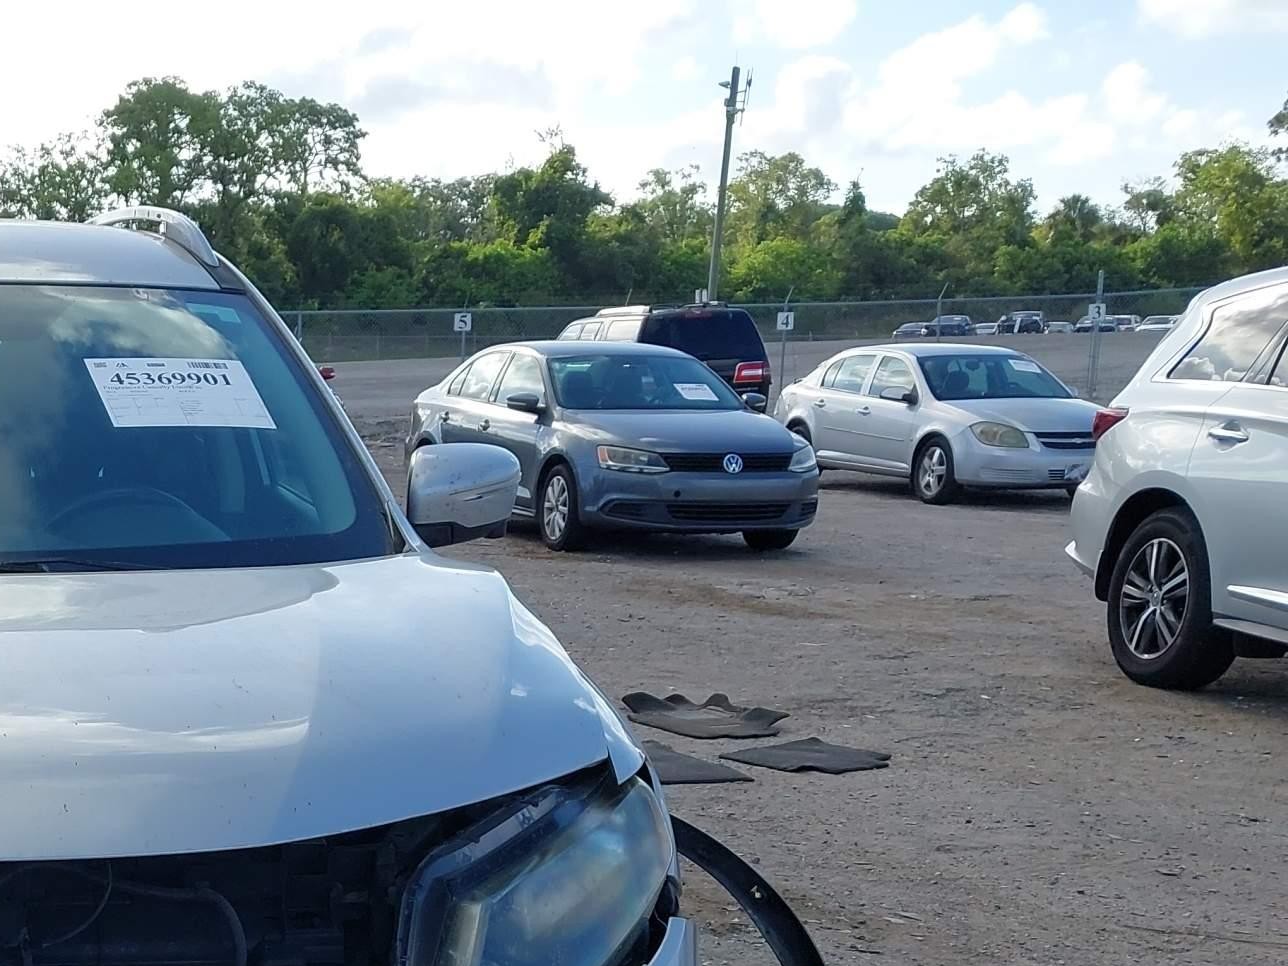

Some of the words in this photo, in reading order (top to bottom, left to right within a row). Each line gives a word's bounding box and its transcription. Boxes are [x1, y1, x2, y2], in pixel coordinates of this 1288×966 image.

[1091, 305, 1101, 319] 3
[458, 314, 468, 329] 5
[780, 315, 789, 327] 4
[110, 372, 232, 386] 45369901
